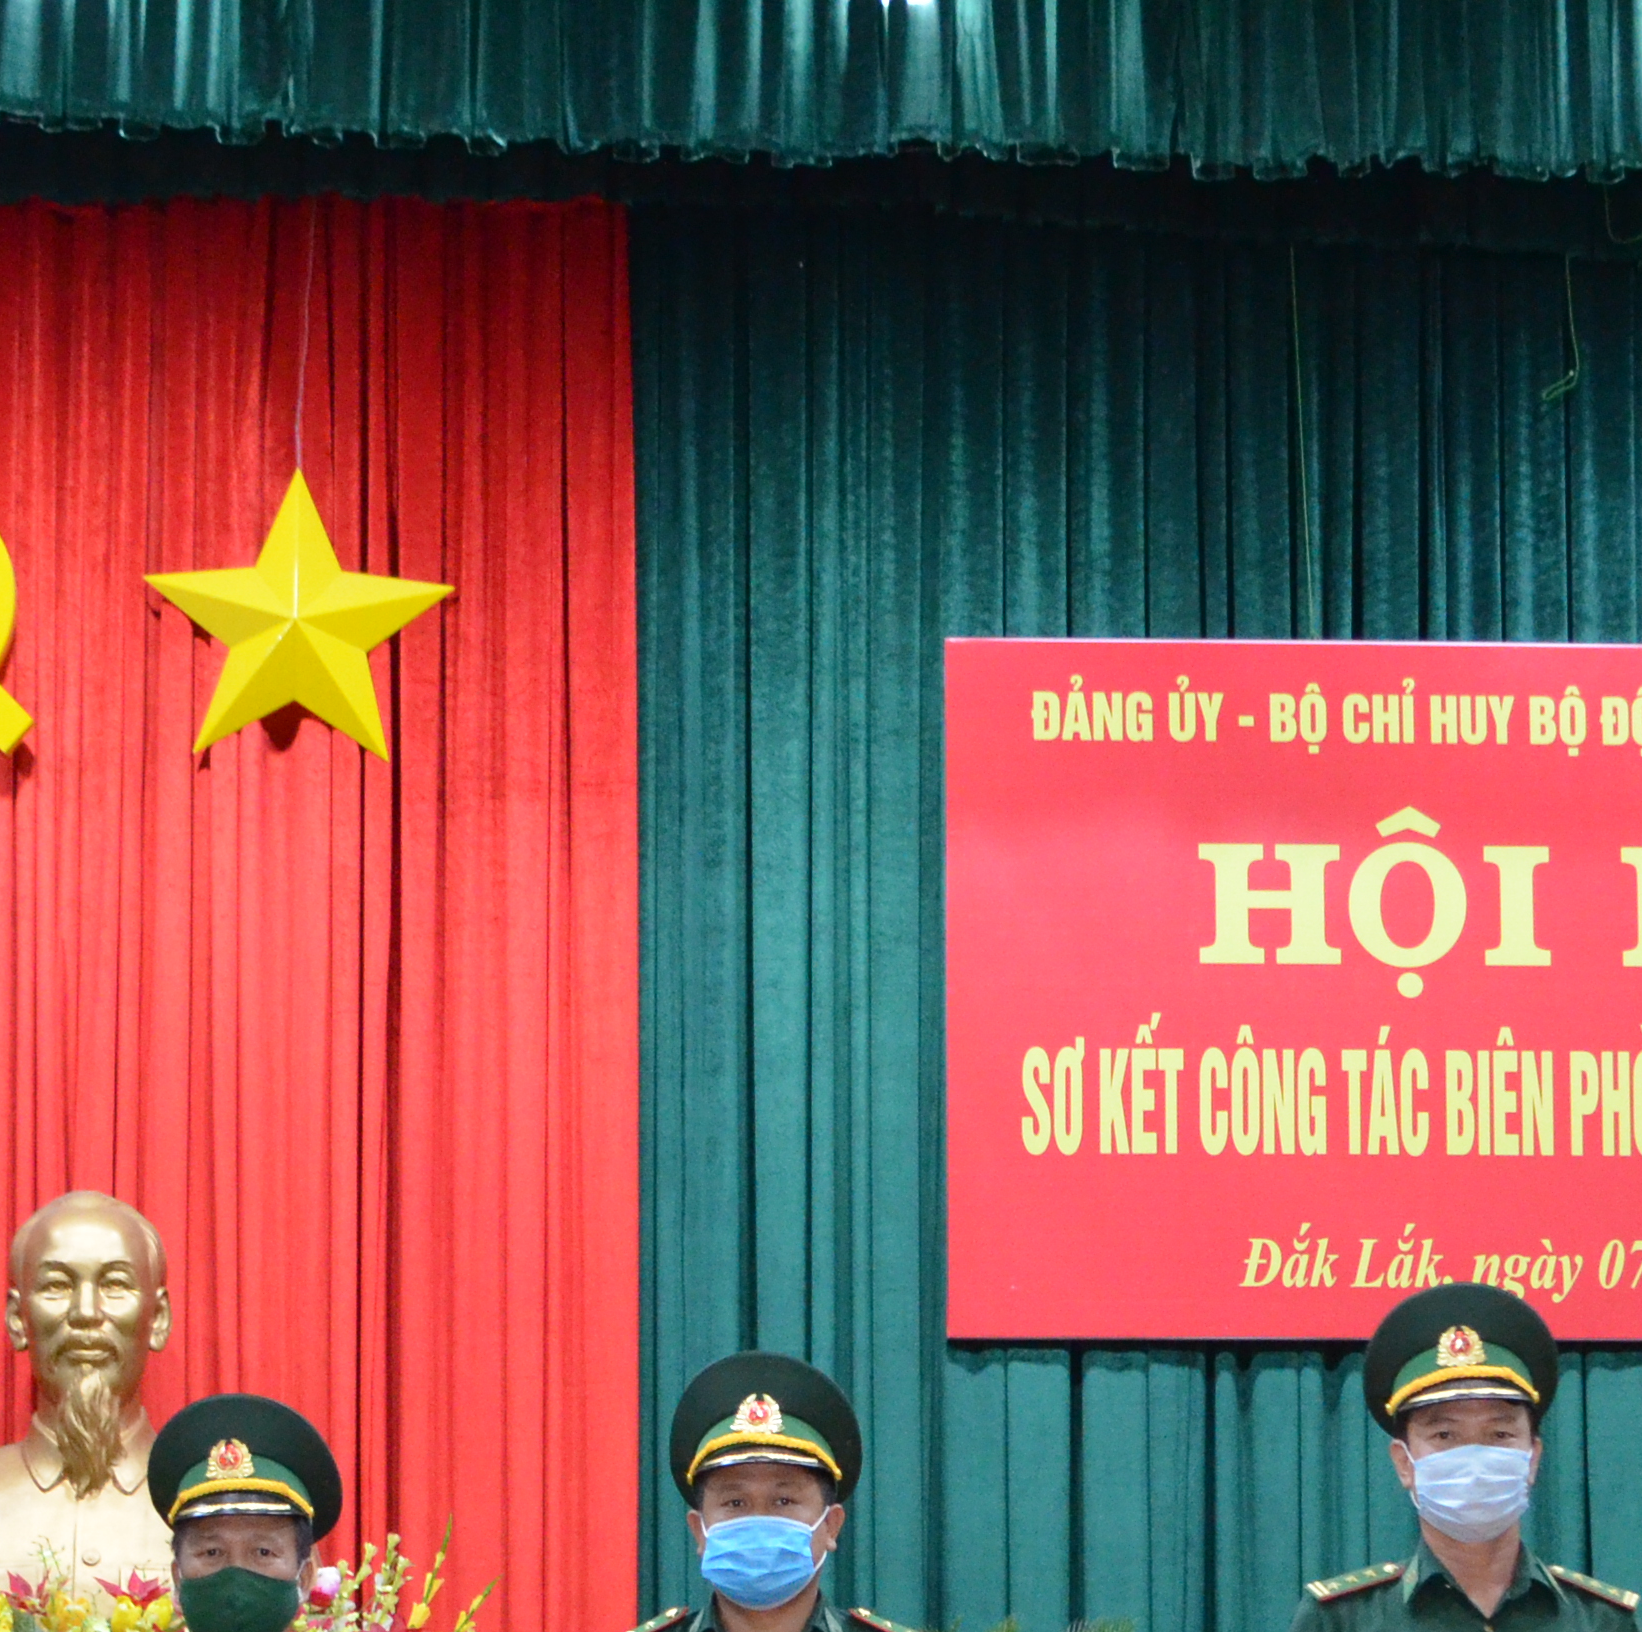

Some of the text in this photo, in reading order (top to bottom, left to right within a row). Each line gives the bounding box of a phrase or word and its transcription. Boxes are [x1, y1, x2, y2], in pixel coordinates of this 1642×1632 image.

[1030, 674, 1154, 743] ĐẢNG
[1167, 674, 1225, 743] ỦY
[1237, 714, 1255, 728] -
[1268, 681, 1328, 755] BỘ
[1342, 676, 1416, 745] CHỈ
[1429, 693, 1516, 746] HUY
[1528, 684, 1588, 758] BỘ
[1197, 805, 1554, 999] HỘI
[1020, 1035, 1086, 1157] SƠ
[1098, 1011, 1185, 1155] KẾT
[1198, 1023, 1328, 1157] CÔNG
[1340, 1024, 1430, 1158] TÁC
[1444, 1025, 1555, 1158] BIÊN
[1238, 1221, 1340, 1289] Đắk
[1471, 1238, 1584, 1304] ngày
